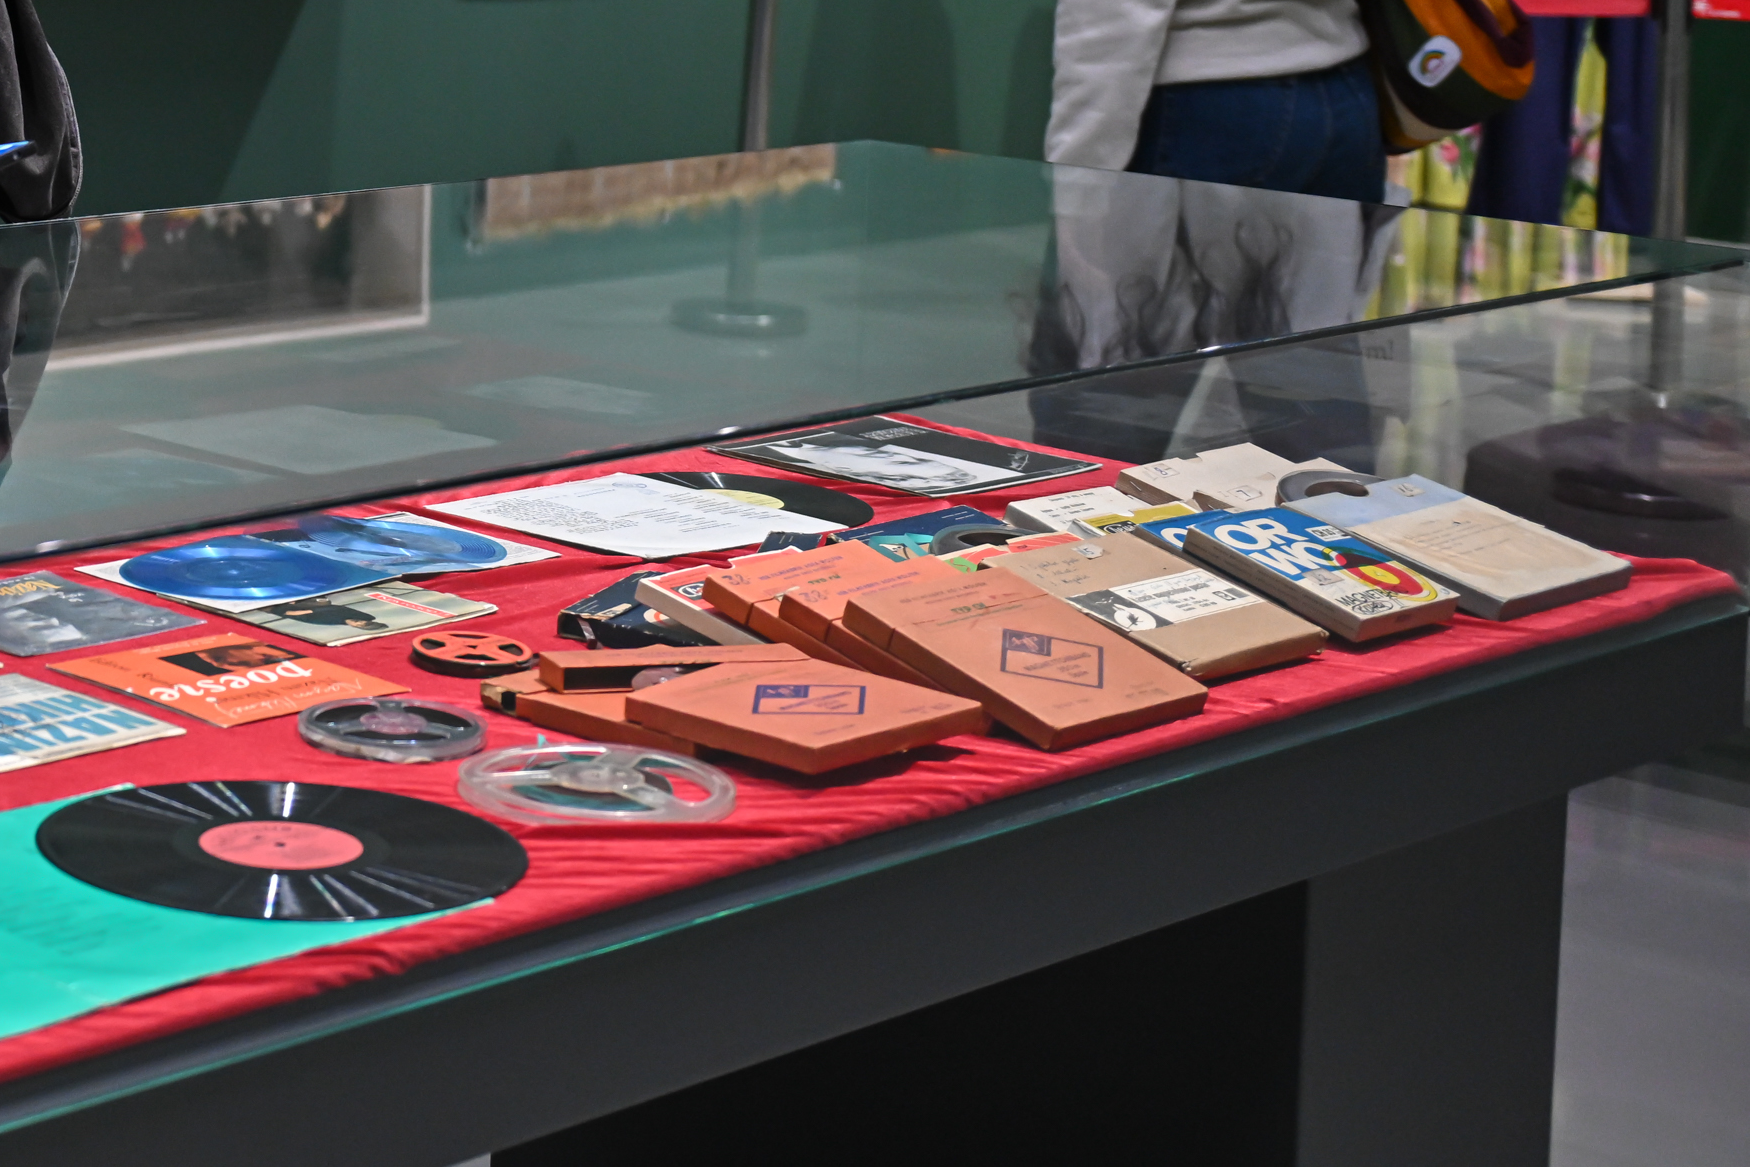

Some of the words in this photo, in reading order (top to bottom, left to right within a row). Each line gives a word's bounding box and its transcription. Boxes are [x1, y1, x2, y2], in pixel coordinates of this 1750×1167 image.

[1213, 517, 1309, 550] OR
[1248, 542, 1347, 576] WO
[149, 658, 313, 703] poesie
